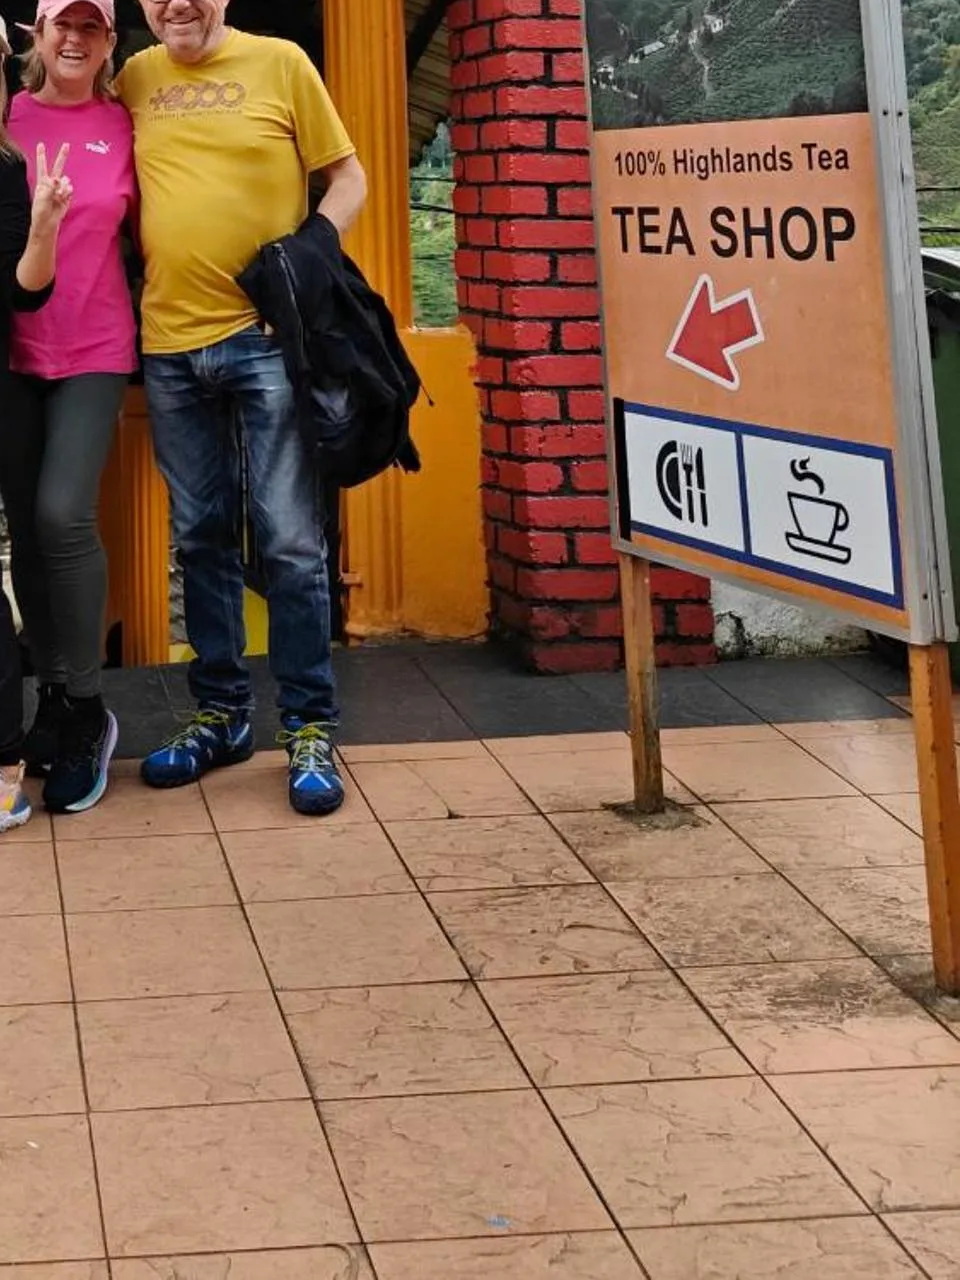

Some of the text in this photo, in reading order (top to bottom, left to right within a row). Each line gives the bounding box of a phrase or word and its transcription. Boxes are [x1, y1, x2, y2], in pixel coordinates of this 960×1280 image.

[614, 143, 850, 181] 100% Highlands Tea
[611, 206, 856, 262] TEA SHOP
